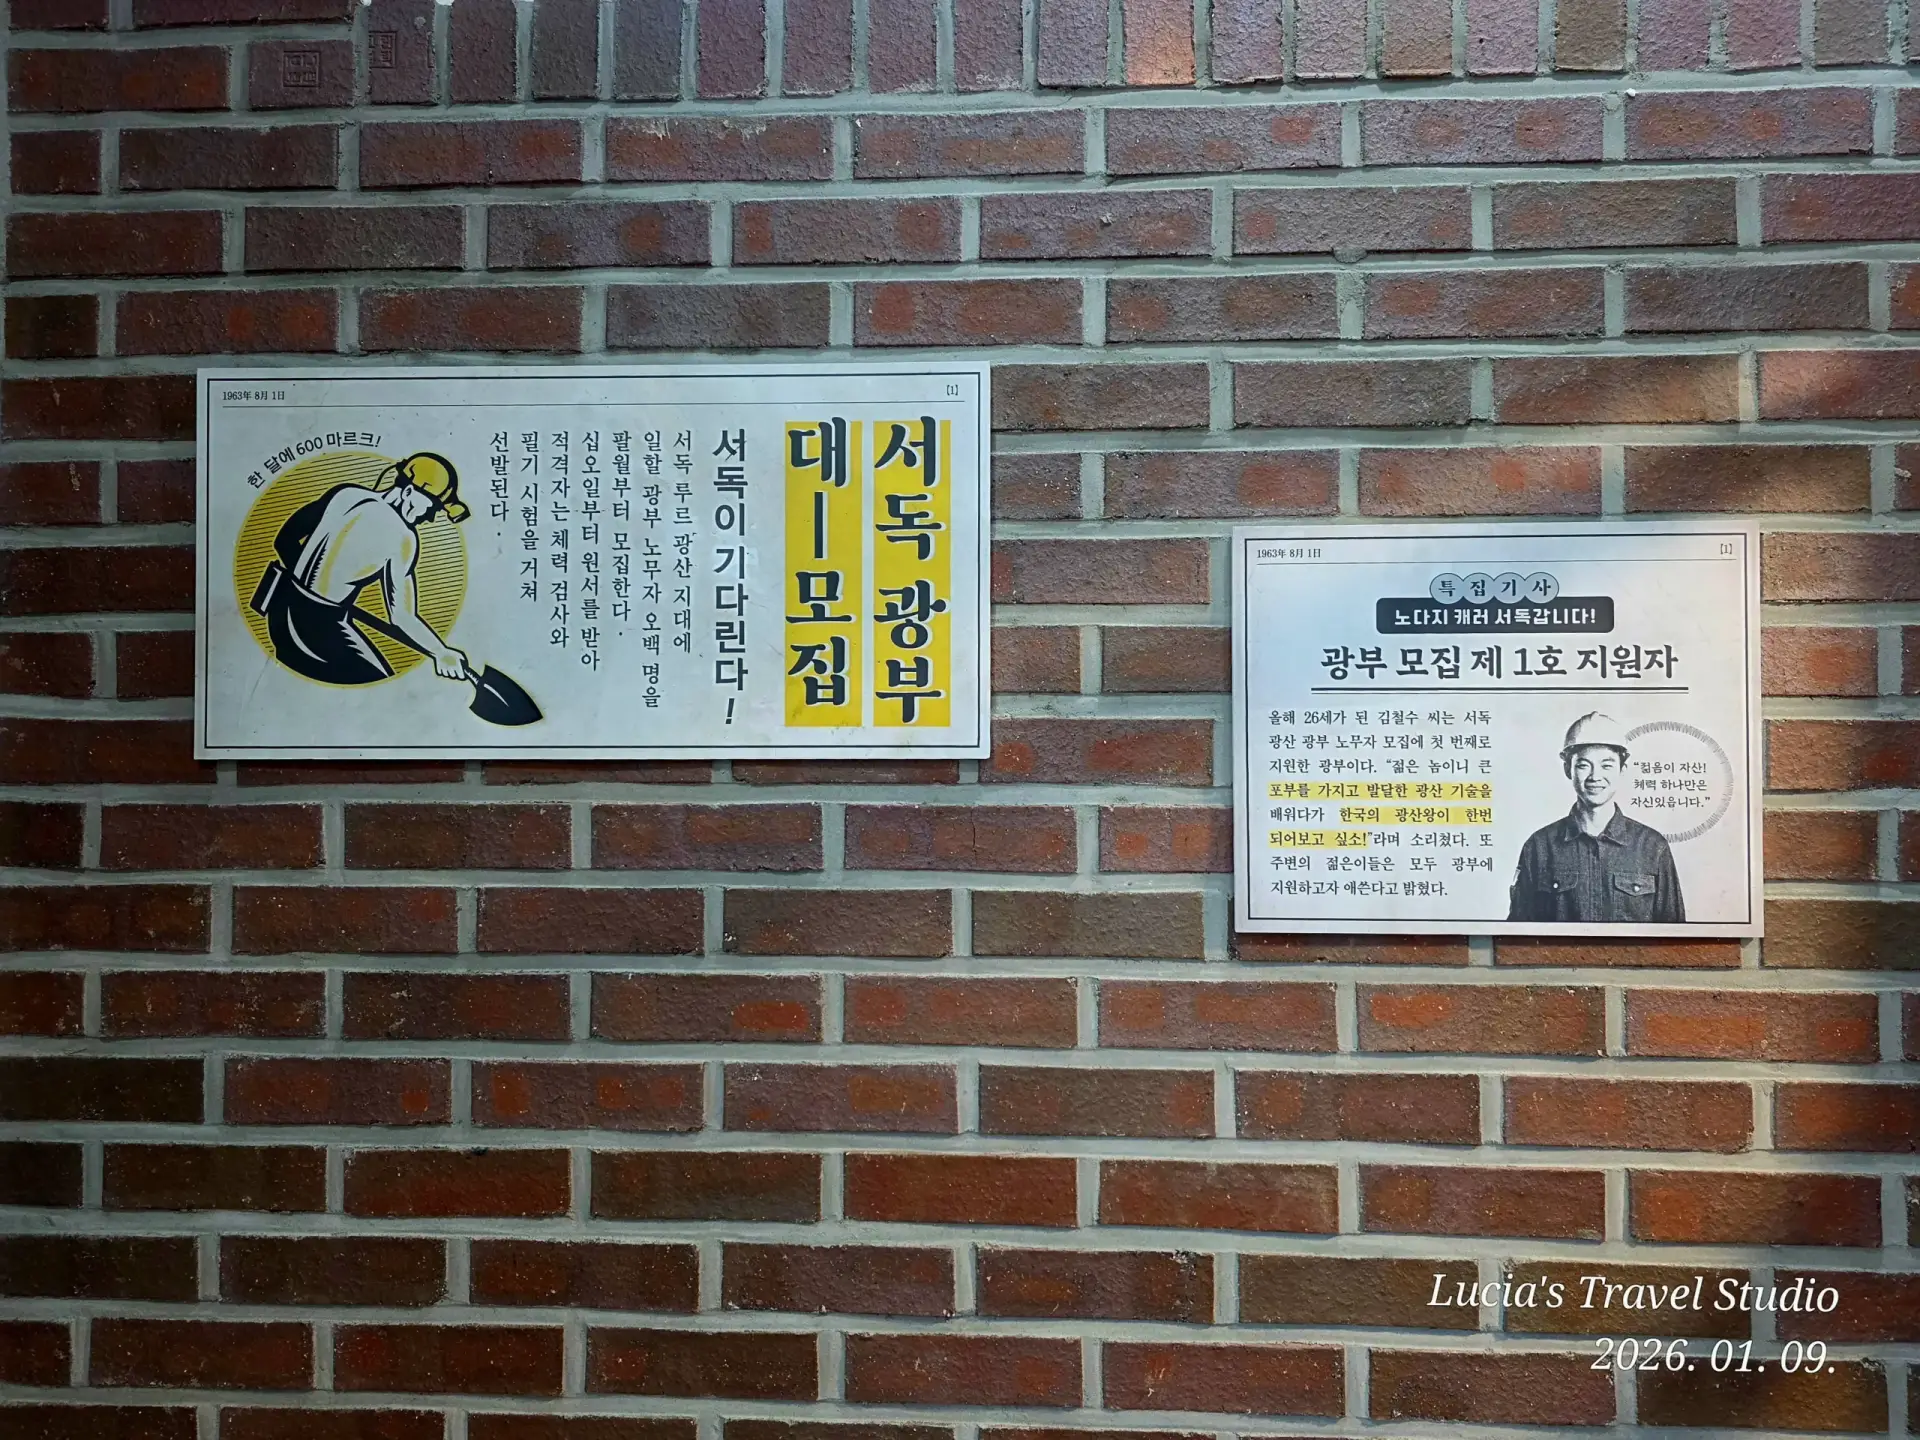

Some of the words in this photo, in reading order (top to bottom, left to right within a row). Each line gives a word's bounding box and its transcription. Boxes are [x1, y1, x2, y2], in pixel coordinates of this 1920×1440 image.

[222, 390, 252, 401] 1963年
[254, 390, 268, 401] 8月
[271, 390, 285, 401] 1日
[247, 472, 266, 489] 한
[264, 447, 296, 475] 달에
[295, 436, 324, 456] 600
[325, 431, 383, 449] 마르크!
[521, 431, 539, 475] 필기
[643, 430, 662, 474] 일할
[673, 430, 693, 474] 서독
[551, 431, 570, 521] 적격자는
[582, 431, 600, 544] 십오일부터
[612, 431, 631, 521] 팔월부터
[712, 429, 748, 536] 서독이
[873, 415, 942, 560] 서독
[521, 483, 539, 550] 시험을
[643, 484, 662, 528] 광부
[673, 483, 692, 524] 루르
[551, 529, 568, 573] 체력
[643, 538, 662, 604] 노무자
[673, 533, 694, 578] 광산
[1257, 548, 1287, 559] 1963年
[1289, 548, 1304, 559] 8月
[1307, 548, 1321, 559] 1日
[520, 558, 537, 602] 거쳐
[581, 552, 600, 619] 원서를
[550, 581, 569, 648] 검사와
[642, 612, 661, 655] 오백
[674, 586, 690, 653] 지대에
[1395, 609, 1448, 626] 노다지
[1454, 609, 1489, 625] 캐러
[1495, 609, 1596, 625] 서독갑니다!
[581, 627, 600, 671] 받아
[873, 579, 947, 724] 광부
[1321, 646, 1387, 680] 광부
[1396, 645, 1460, 679] 모집
[1471, 645, 1501, 679] 제
[1514, 645, 1567, 675] 1호
[1577, 645, 1678, 678] 지원자
[642, 663, 660, 707] 명을
[1269, 711, 1295, 726] 올해
[1304, 710, 1347, 725] 26세가
[1355, 711, 1369, 726] 된
[1379, 710, 1419, 726] 김철수
[1428, 711, 1455, 726] 씨는
[1464, 711, 1492, 726] 서독
[1269, 735, 1297, 750] 광산
[1302, 735, 1330, 750] 광부
[1336, 735, 1378, 750] 노무자
[1383, 735, 1424, 750] 모집에
[1431, 735, 1444, 750] 첫
[1451, 735, 1492, 750] 번째로
[1270, 759, 1311, 774] 지원한
[1319, 759, 1377, 774] 광부이다.
[1428, 759, 1469, 774] 놈이니
[1478, 759, 1492, 774] 큰
[1633, 778, 1657, 791] 체력
[1659, 779, 1708, 792] 하나만은
[1679, 761, 1707, 774] 자산!
[1270, 783, 1311, 798] 포부를
[1319, 783, 1360, 799] 가지고
[1367, 783, 1409, 799] 발달한
[1416, 784, 1444, 799] 광산
[1451, 784, 1493, 799] 기술을
[1270, 807, 1325, 823] 배워다가
[1340, 808, 1380, 823] 한국의
[1395, 808, 1449, 823] 광산왕이
[1465, 808, 1493, 823] 한번
[1271, 831, 1325, 847] 되어보고
[1411, 832, 1470, 848] 소리쳤다.
[1479, 833, 1494, 847] 또
[1271, 856, 1311, 871] 주변의
[1327, 856, 1396, 872] 젊은이들은
[1410, 857, 1438, 872] 모두
[1452, 857, 1493, 873] 광부에
[1272, 880, 1340, 896] 지원하고자
[1344, 881, 1399, 896] 애쓴다고
[1403, 881, 1448, 897] 밝혔다.
